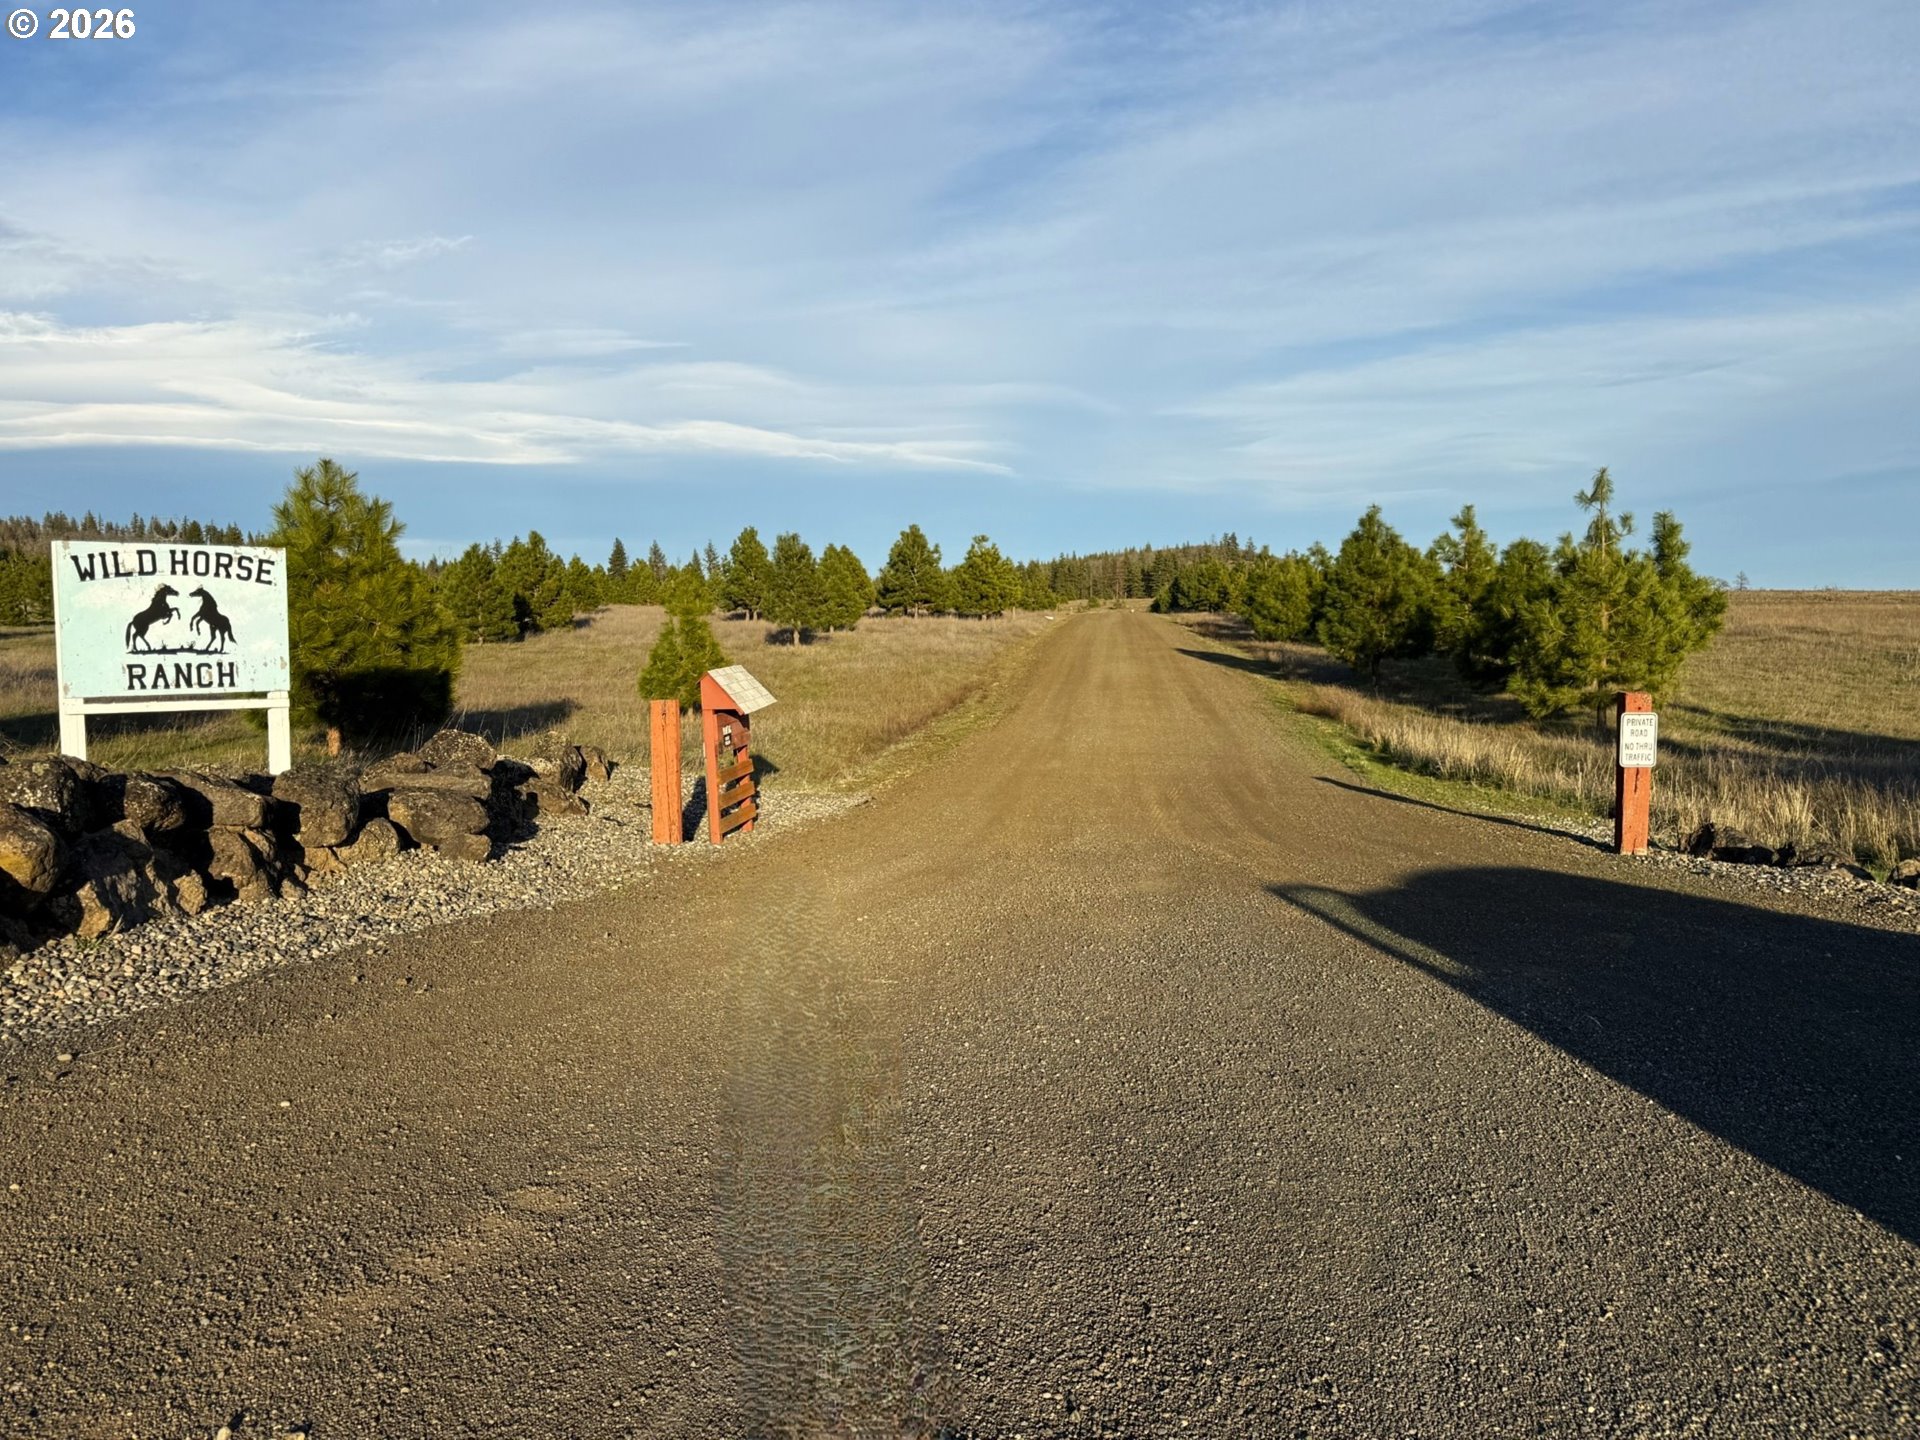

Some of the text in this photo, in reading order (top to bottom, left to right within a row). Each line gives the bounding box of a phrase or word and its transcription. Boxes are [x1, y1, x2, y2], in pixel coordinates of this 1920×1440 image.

[70, 549, 276, 586] WILD HORSE
[126, 661, 236, 690] RANCH
[1626, 718, 1654, 727] PRIVATE
[1630, 729, 1648, 737] ROAD
[1624, 742, 1653, 751] NO THRU
[1625, 753, 1652, 761] TRAFFIC
